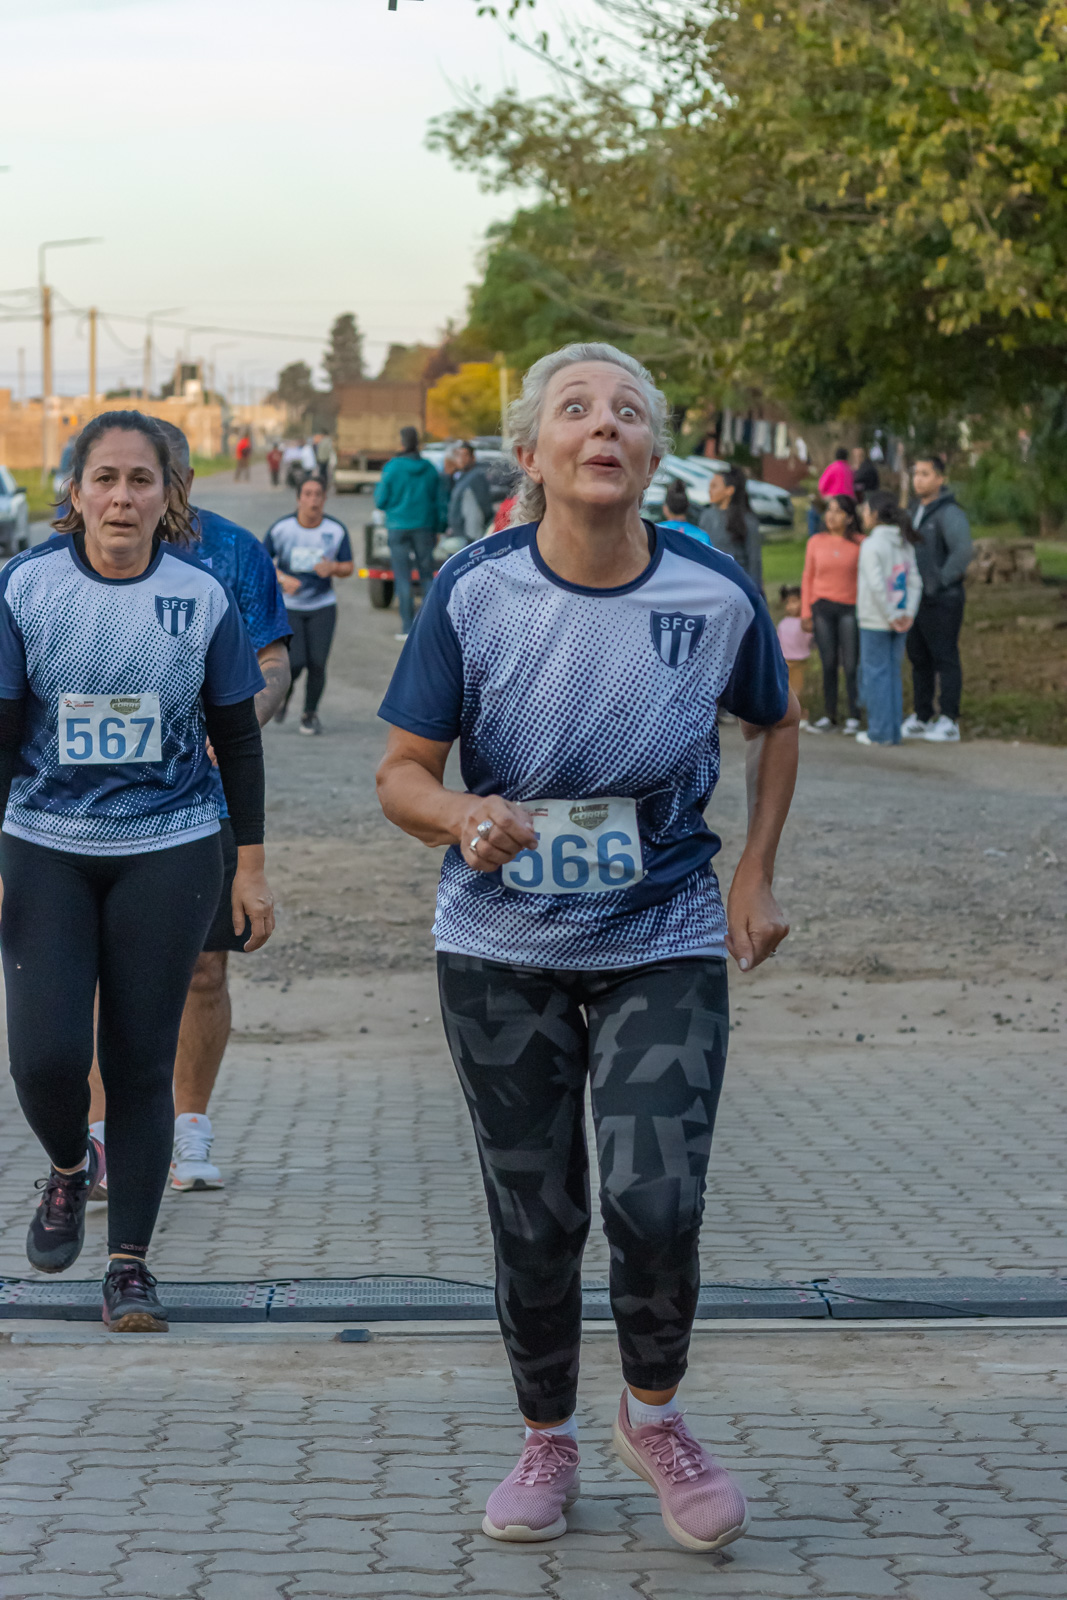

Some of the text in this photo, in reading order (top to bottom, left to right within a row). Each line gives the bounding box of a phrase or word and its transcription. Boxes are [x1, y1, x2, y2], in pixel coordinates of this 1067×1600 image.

[162, 599, 189, 611] SFC
[660, 616, 696, 632] SFC
[66, 717, 156, 761] 567
[509, 830, 636, 889] 566
